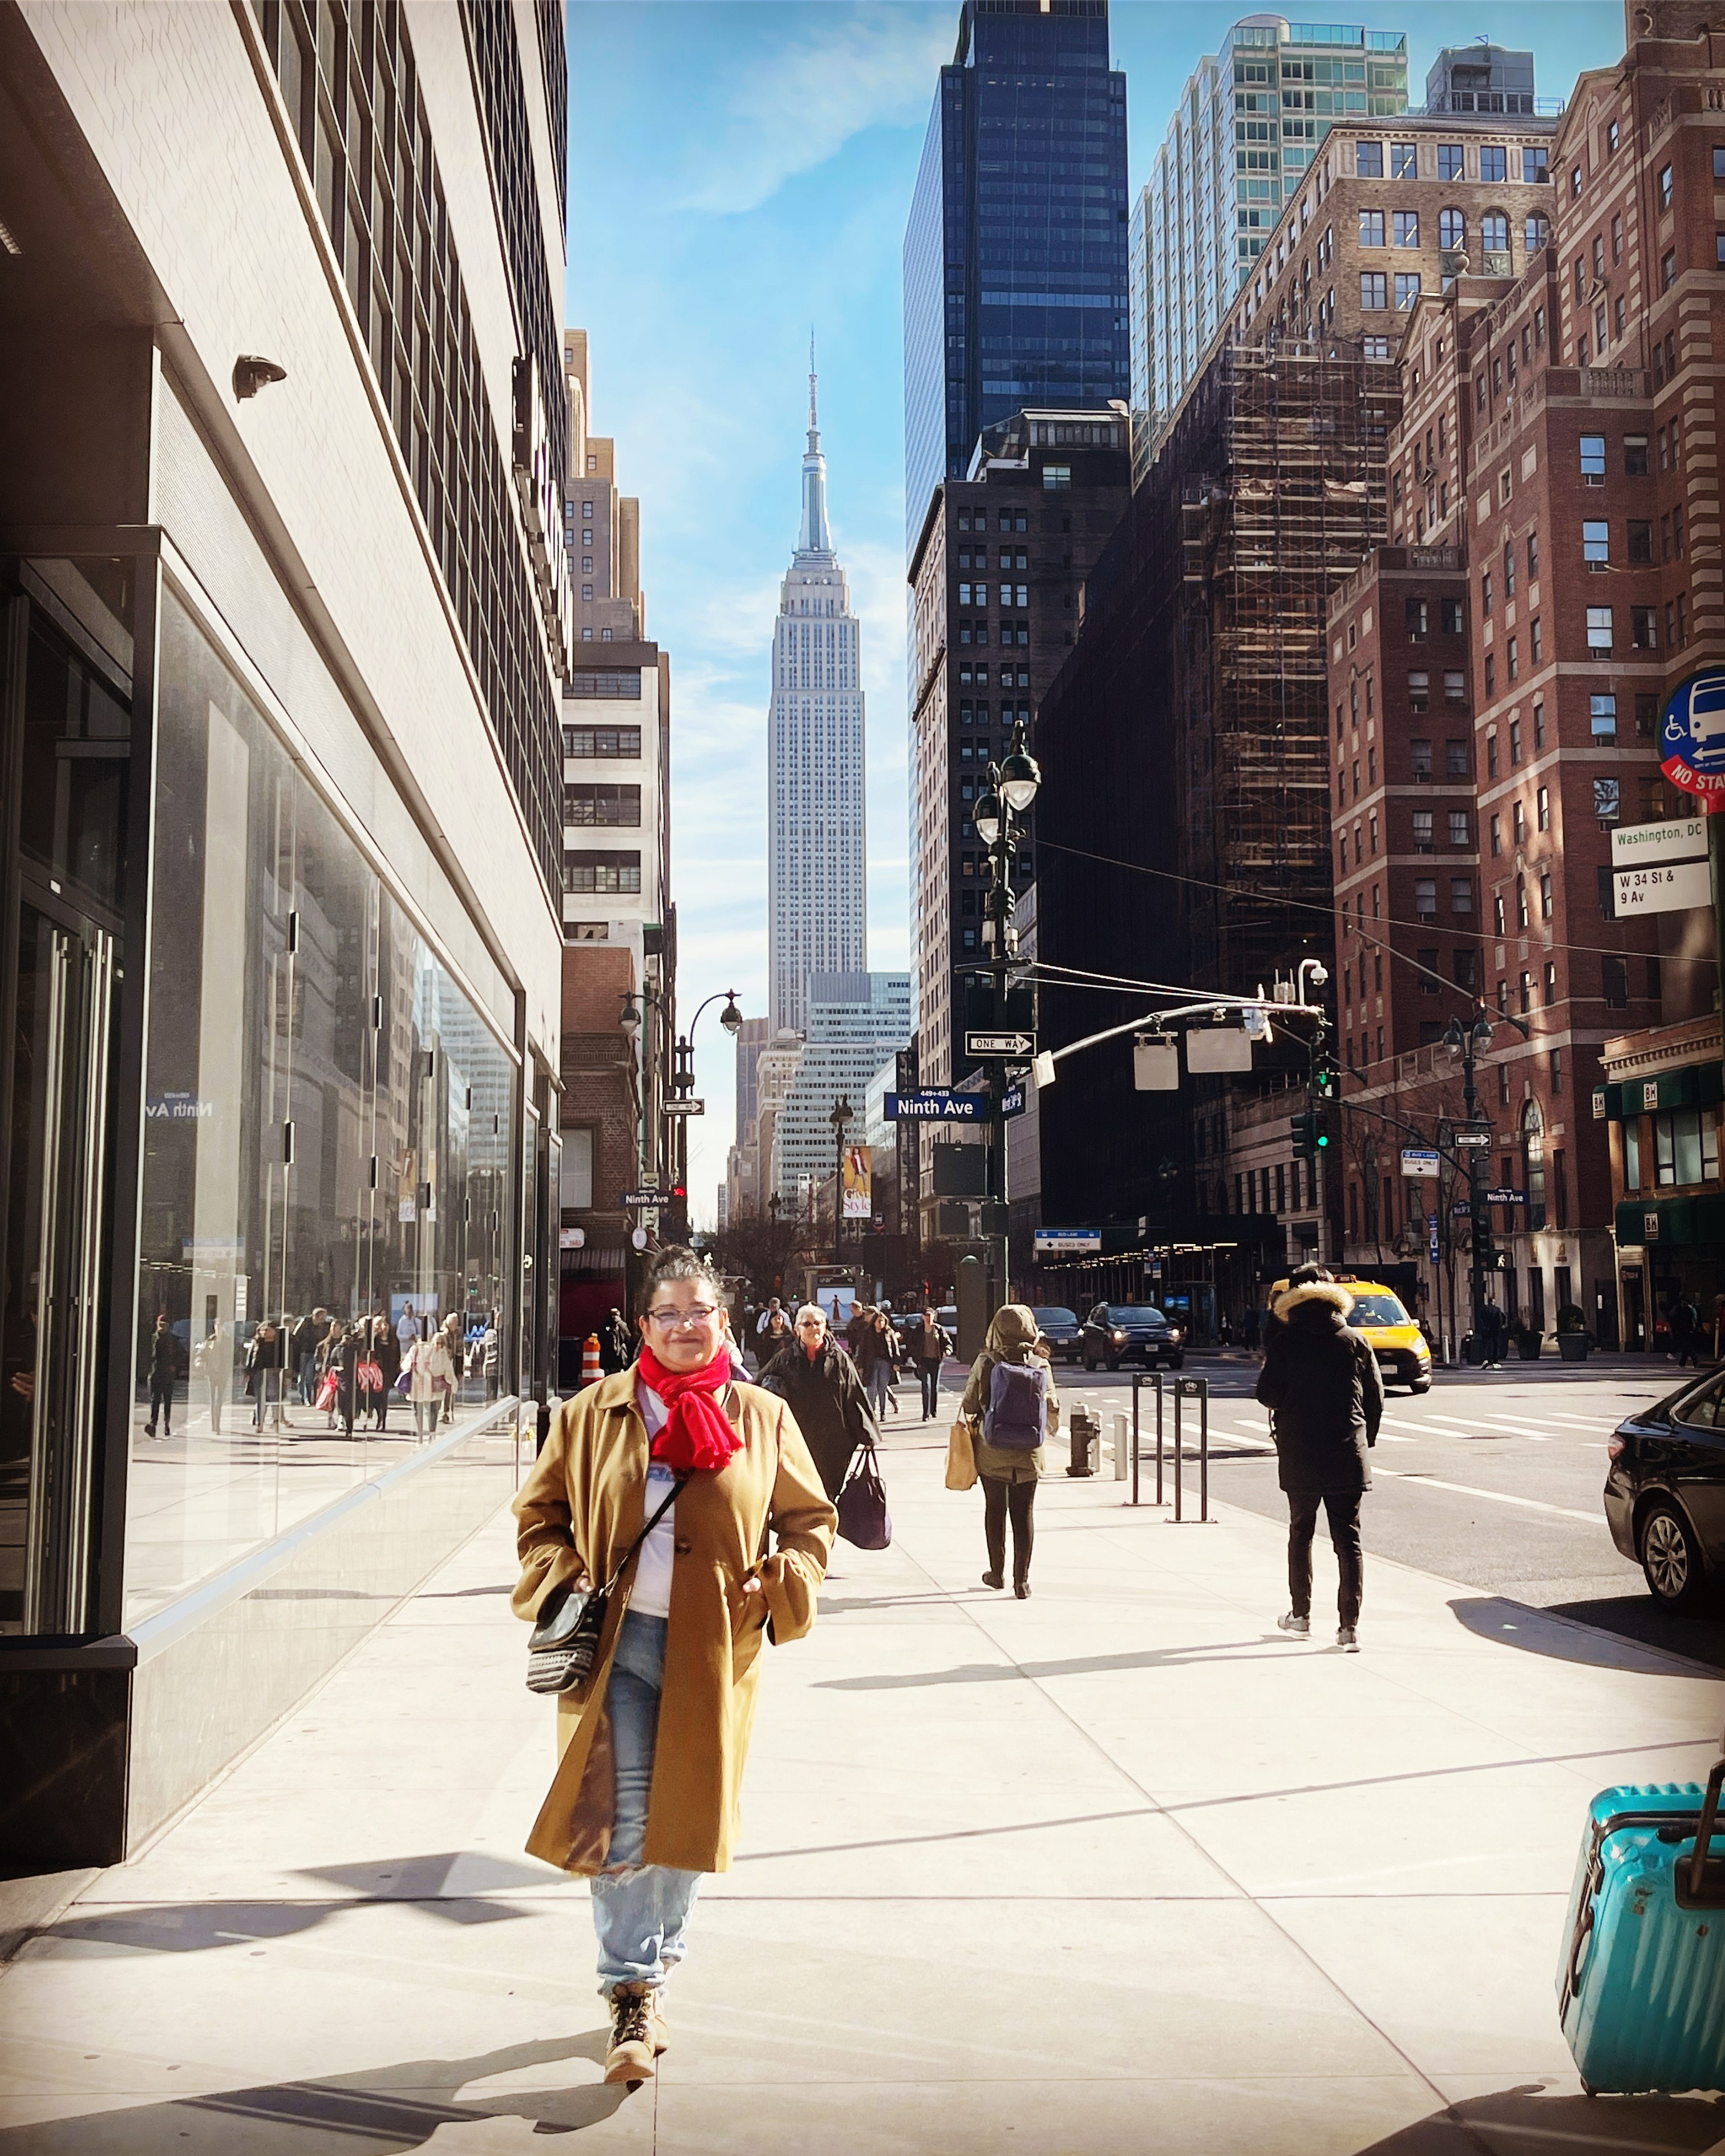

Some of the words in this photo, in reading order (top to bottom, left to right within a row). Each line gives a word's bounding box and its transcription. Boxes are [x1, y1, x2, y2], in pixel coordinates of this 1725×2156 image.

[1671, 764, 1692, 784] NO
[1695, 773, 1725, 790] STA
[1617, 828, 1683, 845] Washington,
[1687, 823, 1702, 836] DC
[1620, 875, 1630, 887] W
[1634, 873, 1647, 886] 34
[1651, 872, 1662, 884] St
[1666, 870, 1674, 882] &
[1621, 892, 1627, 904] 9
[1631, 891, 1644, 902] Av
[976, 1039, 995, 1048] ONE
[1005, 1039, 1025, 1048] WAY
[897, 1099, 940, 1115] Ninth
[944, 1100, 973, 1115] Ave
[625, 1194, 650, 1204] Ninth
[651, 1194, 669, 1203] Ave
[1487, 1193, 1508, 1202] Ninth
[843, 1198, 870, 1213] Style
